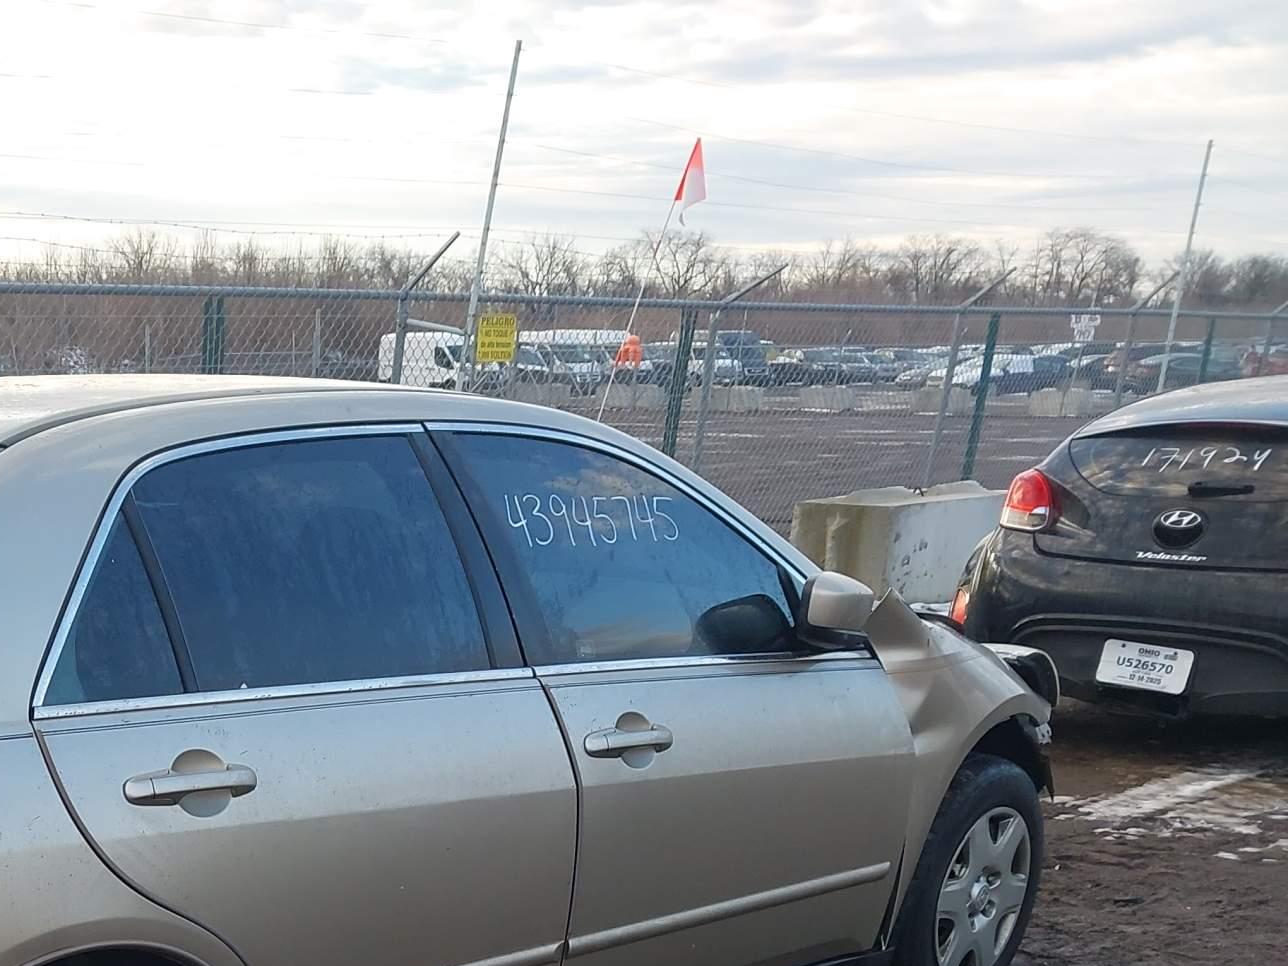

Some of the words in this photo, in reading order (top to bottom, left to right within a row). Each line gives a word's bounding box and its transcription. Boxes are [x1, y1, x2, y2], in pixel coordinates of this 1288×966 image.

[481, 316, 515, 327] PELIGRO
[493, 330, 509, 338] TOQUE
[1141, 446, 1273, 473] 171924
[504, 494, 680, 548] 43945745
[1136, 551, 1208, 561] Veloster
[1138, 647, 1161, 657] OHIO
[1116, 656, 1174, 674] U526570
